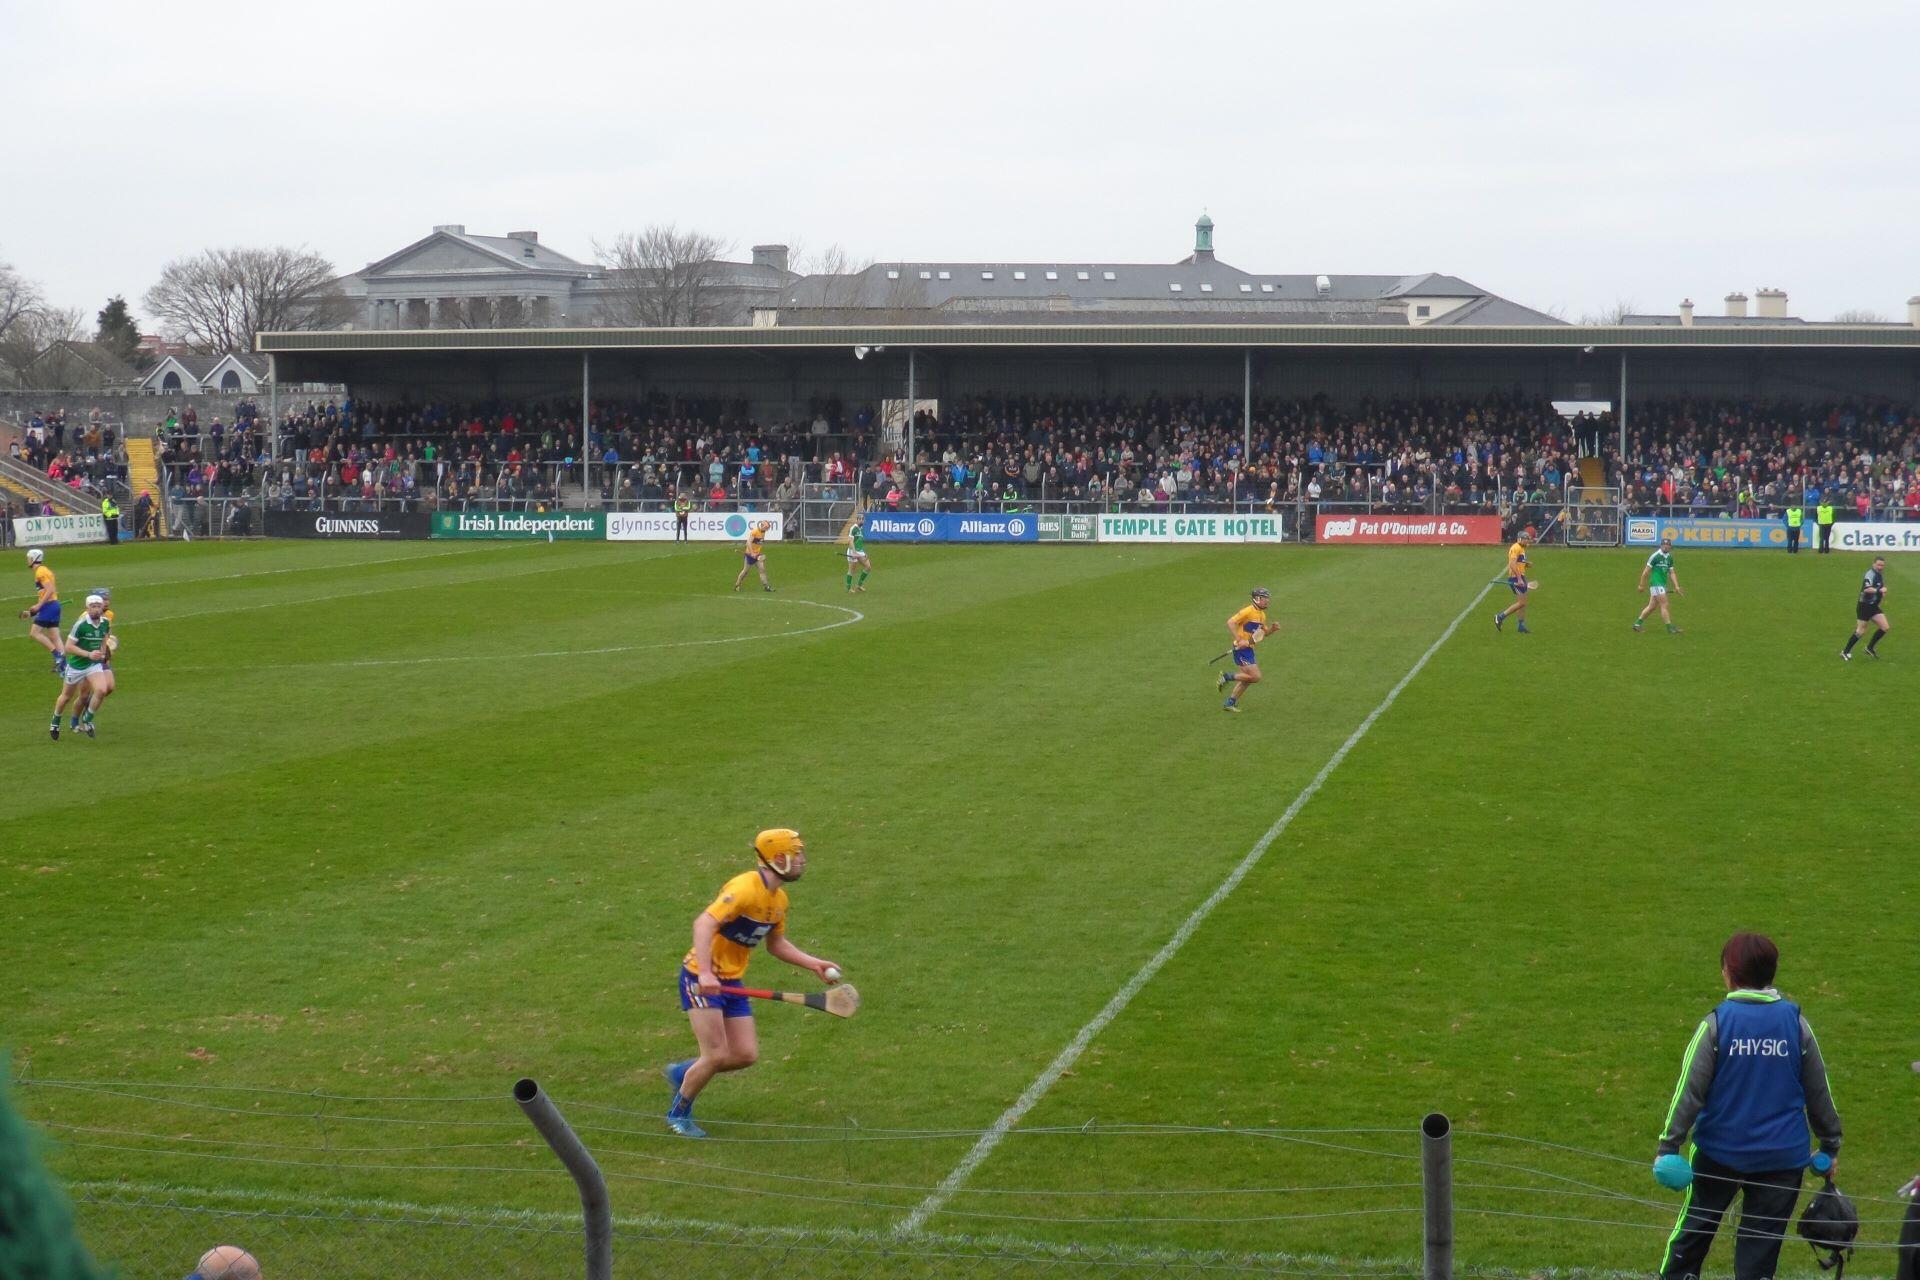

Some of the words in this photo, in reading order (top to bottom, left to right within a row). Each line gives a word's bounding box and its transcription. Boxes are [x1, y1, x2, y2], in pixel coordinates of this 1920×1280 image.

[26, 520, 42, 532] ON
[47, 517, 74, 530] YOUR
[79, 516, 101, 528] SIDE
[315, 516, 379, 533] GUINNESS
[458, 515, 495, 531] Irish
[498, 515, 595, 534] Independent
[611, 517, 724, 534] glynnscoches
[870, 519, 915, 533] Allianz
[960, 520, 1005, 533] Allianz
[1103, 519, 1167, 536] TEMPLE
[1174, 519, 1216, 536] GATE
[1223, 519, 1278, 536] HOTEL
[1359, 522, 1379, 535] Pat
[1381, 522, 1436, 535] O'Donnell
[1438, 522, 1448, 535] &
[1449, 522, 1468, 535] Co.
[1661, 526, 1762, 543] O'KEEFFE
[1769, 528, 1809, 543] OL
